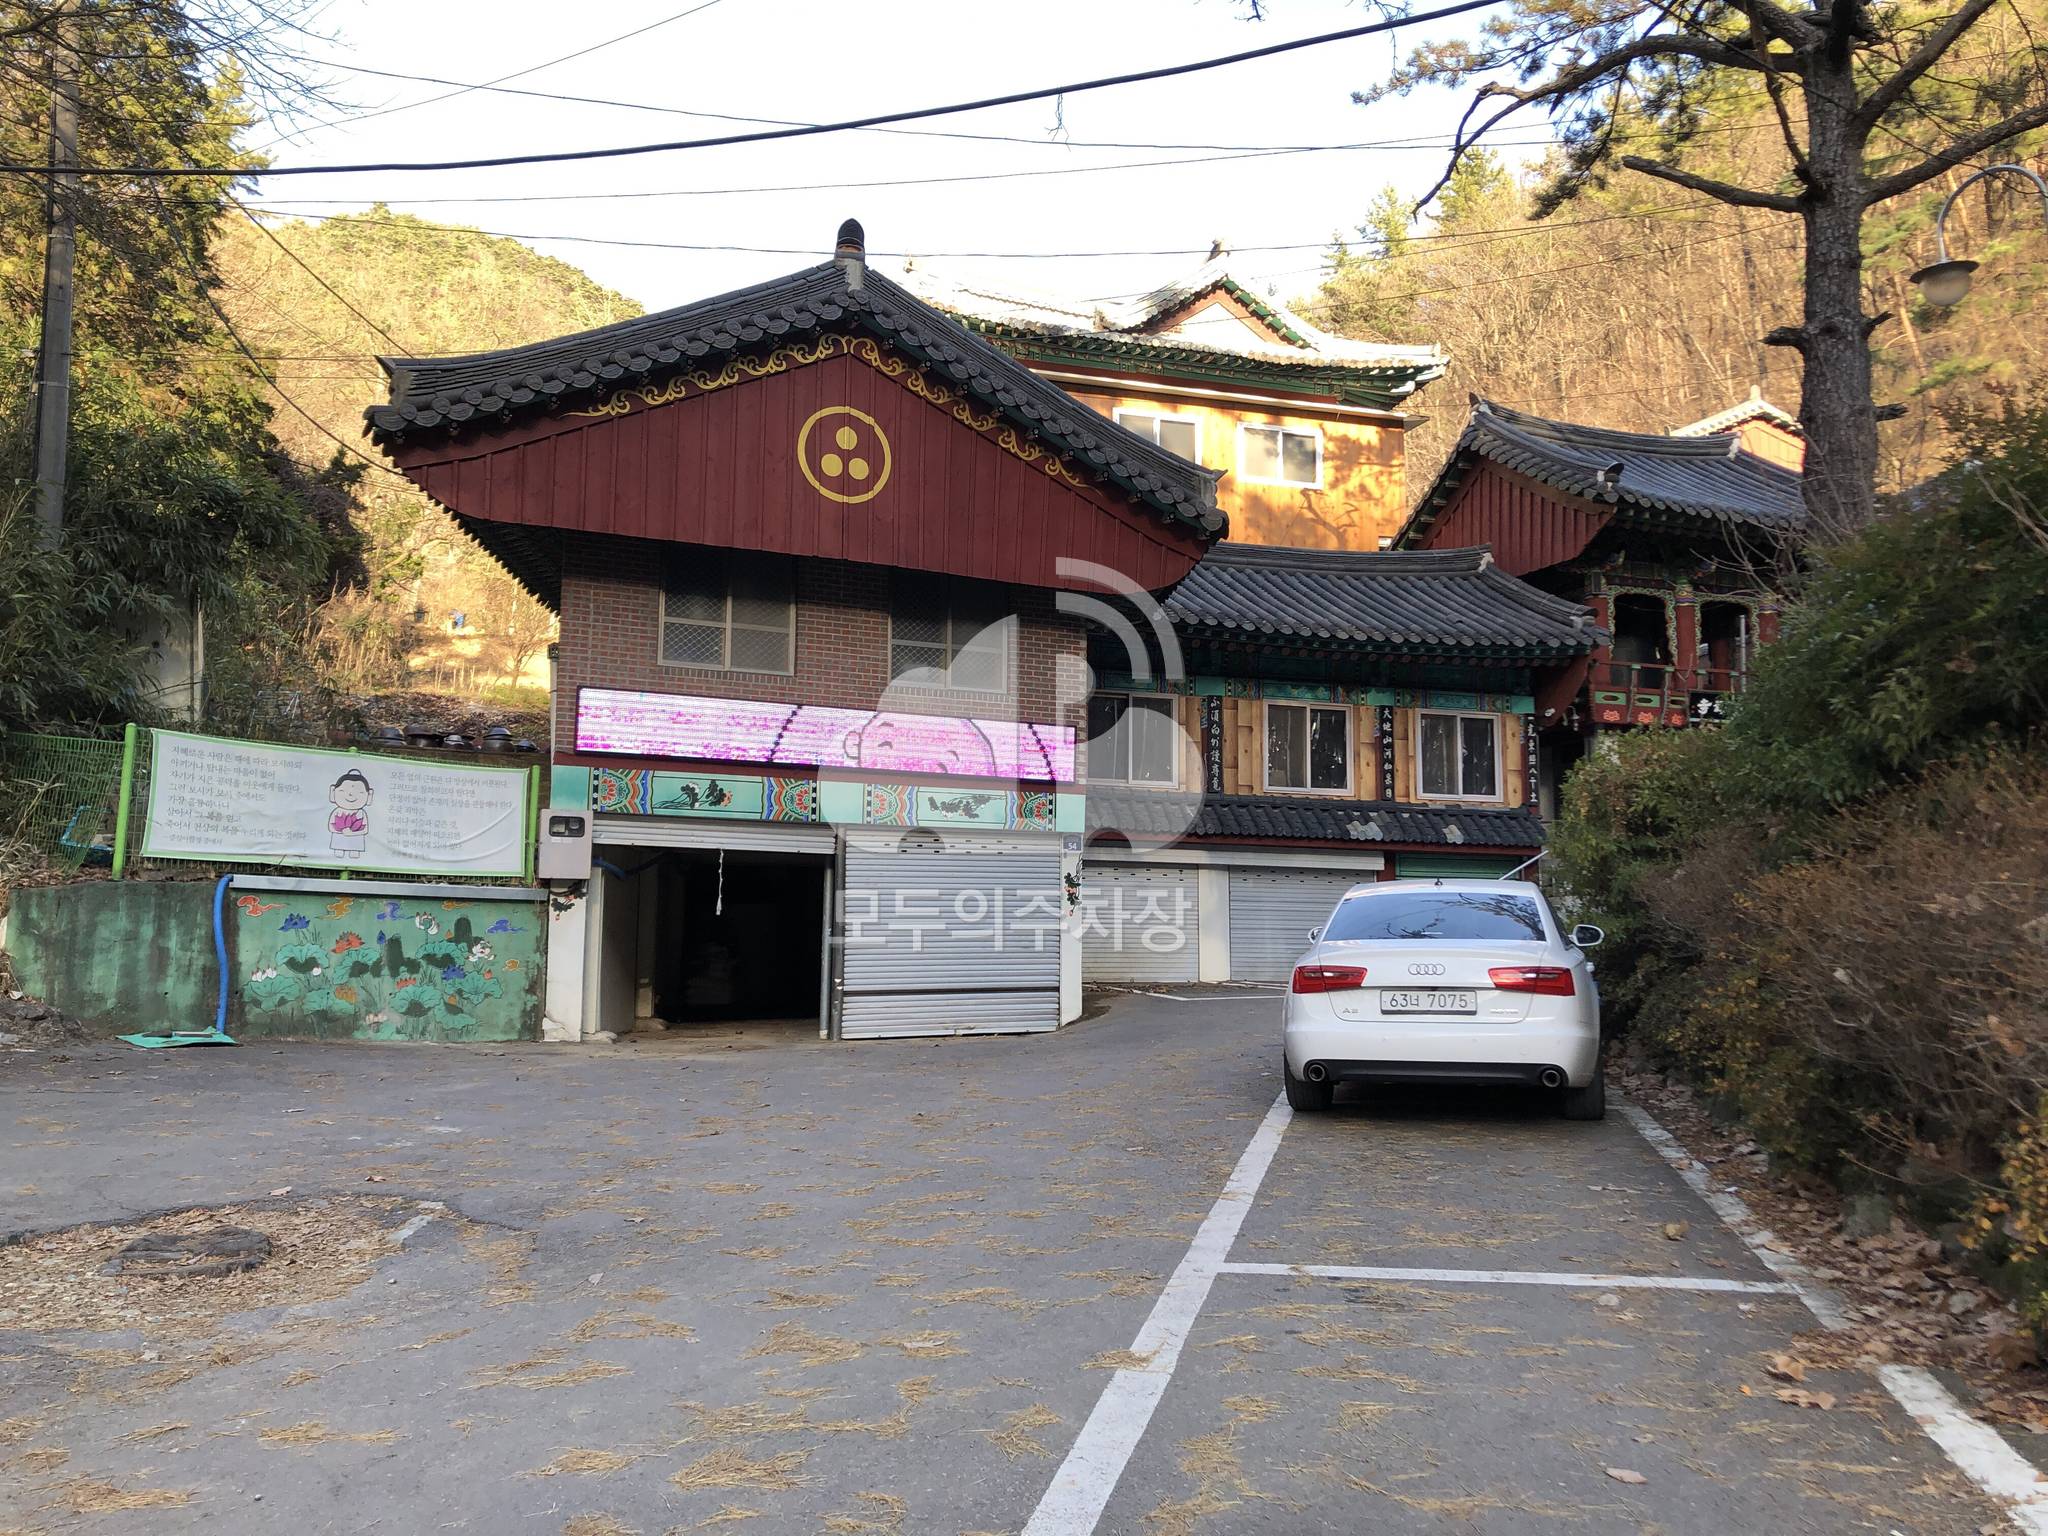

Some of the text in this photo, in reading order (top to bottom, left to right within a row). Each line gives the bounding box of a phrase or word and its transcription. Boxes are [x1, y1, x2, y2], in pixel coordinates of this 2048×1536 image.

[1068, 842, 1077, 850] 54
[1389, 992, 1468, 1009] 63너 7075
